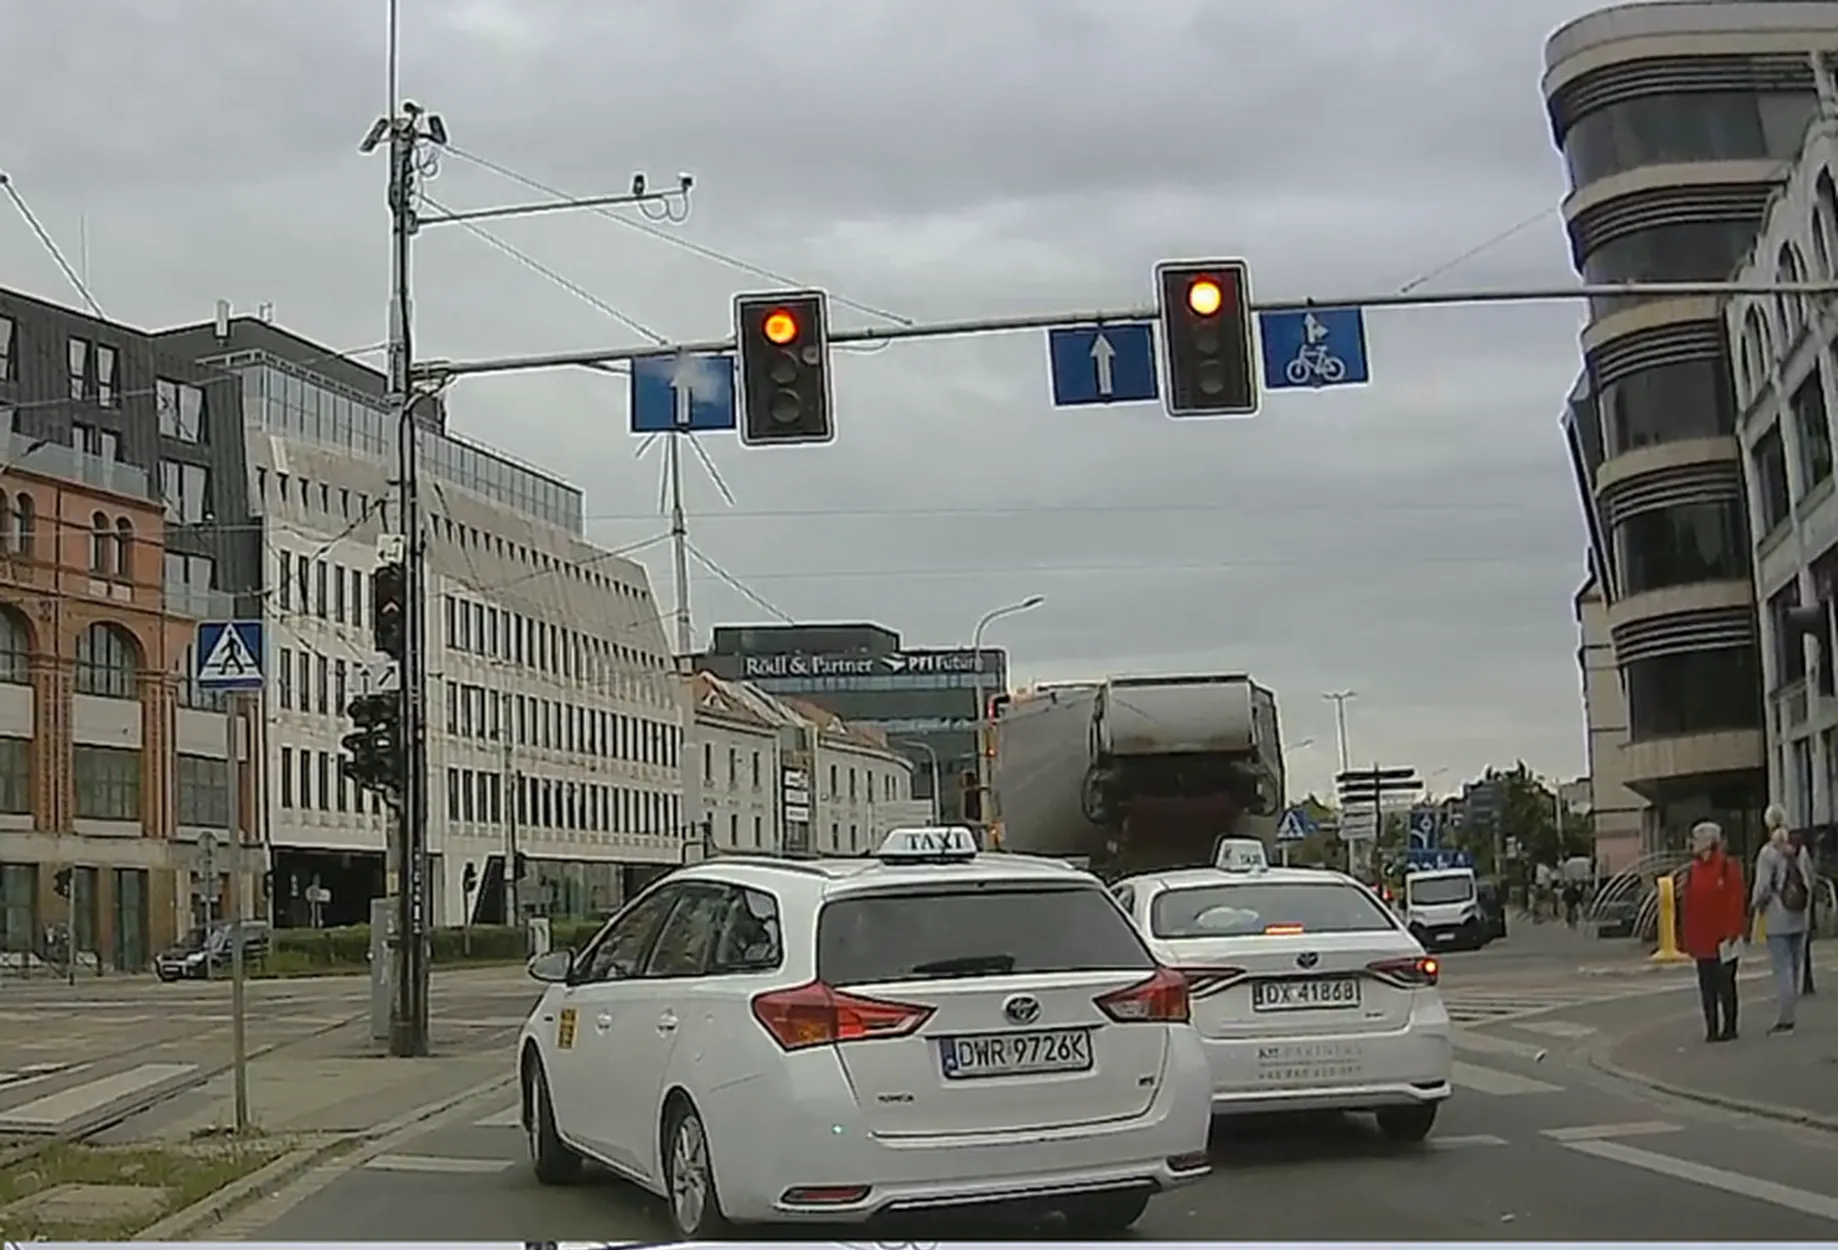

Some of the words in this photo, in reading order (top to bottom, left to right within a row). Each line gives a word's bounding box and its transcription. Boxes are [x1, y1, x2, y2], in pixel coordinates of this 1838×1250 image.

[747, 655, 787, 674] Rödl
[789, 655, 808, 674] &
[812, 655, 875, 674] Partner
[908, 655, 933, 671] PFI
[905, 833, 963, 850] TAXI
[959, 1038, 1006, 1067] DWR
[1013, 1033, 1086, 1065] 9726K
